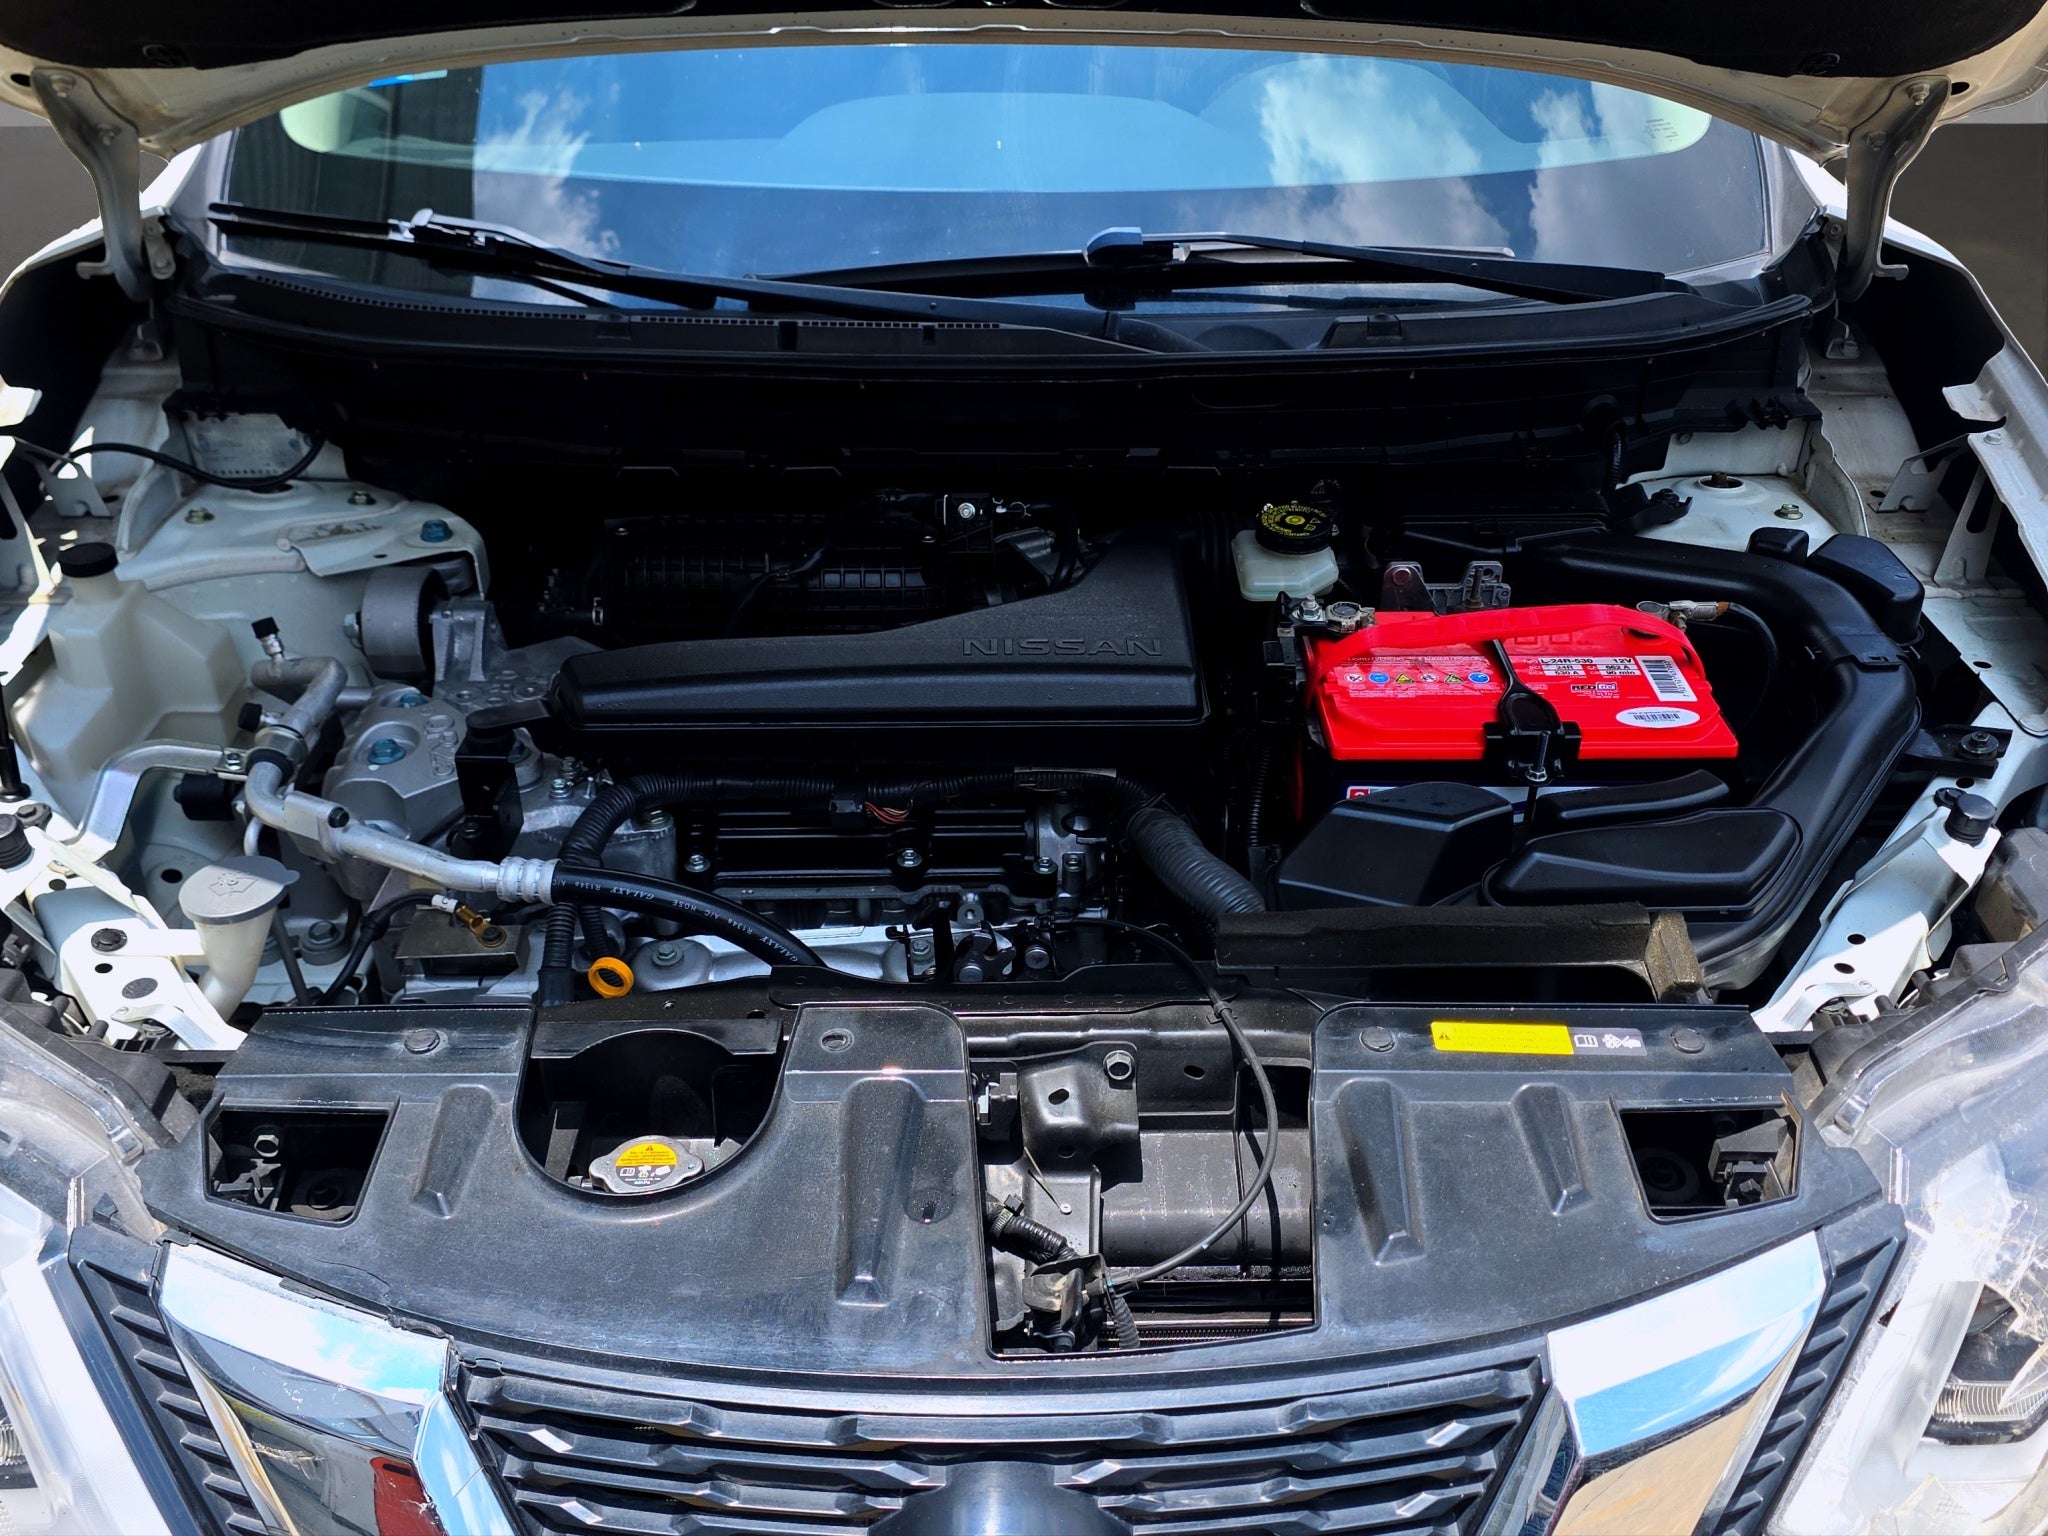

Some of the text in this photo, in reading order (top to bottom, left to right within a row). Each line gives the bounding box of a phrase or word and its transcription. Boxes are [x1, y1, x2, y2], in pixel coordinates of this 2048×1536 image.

[962, 638, 1163, 657] NISSAN
[610, 886, 655, 900] GALAXY
[672, 898, 697, 912] HOSE
[704, 909, 720, 920] A/C
[760, 935, 799, 962] GALAXY
